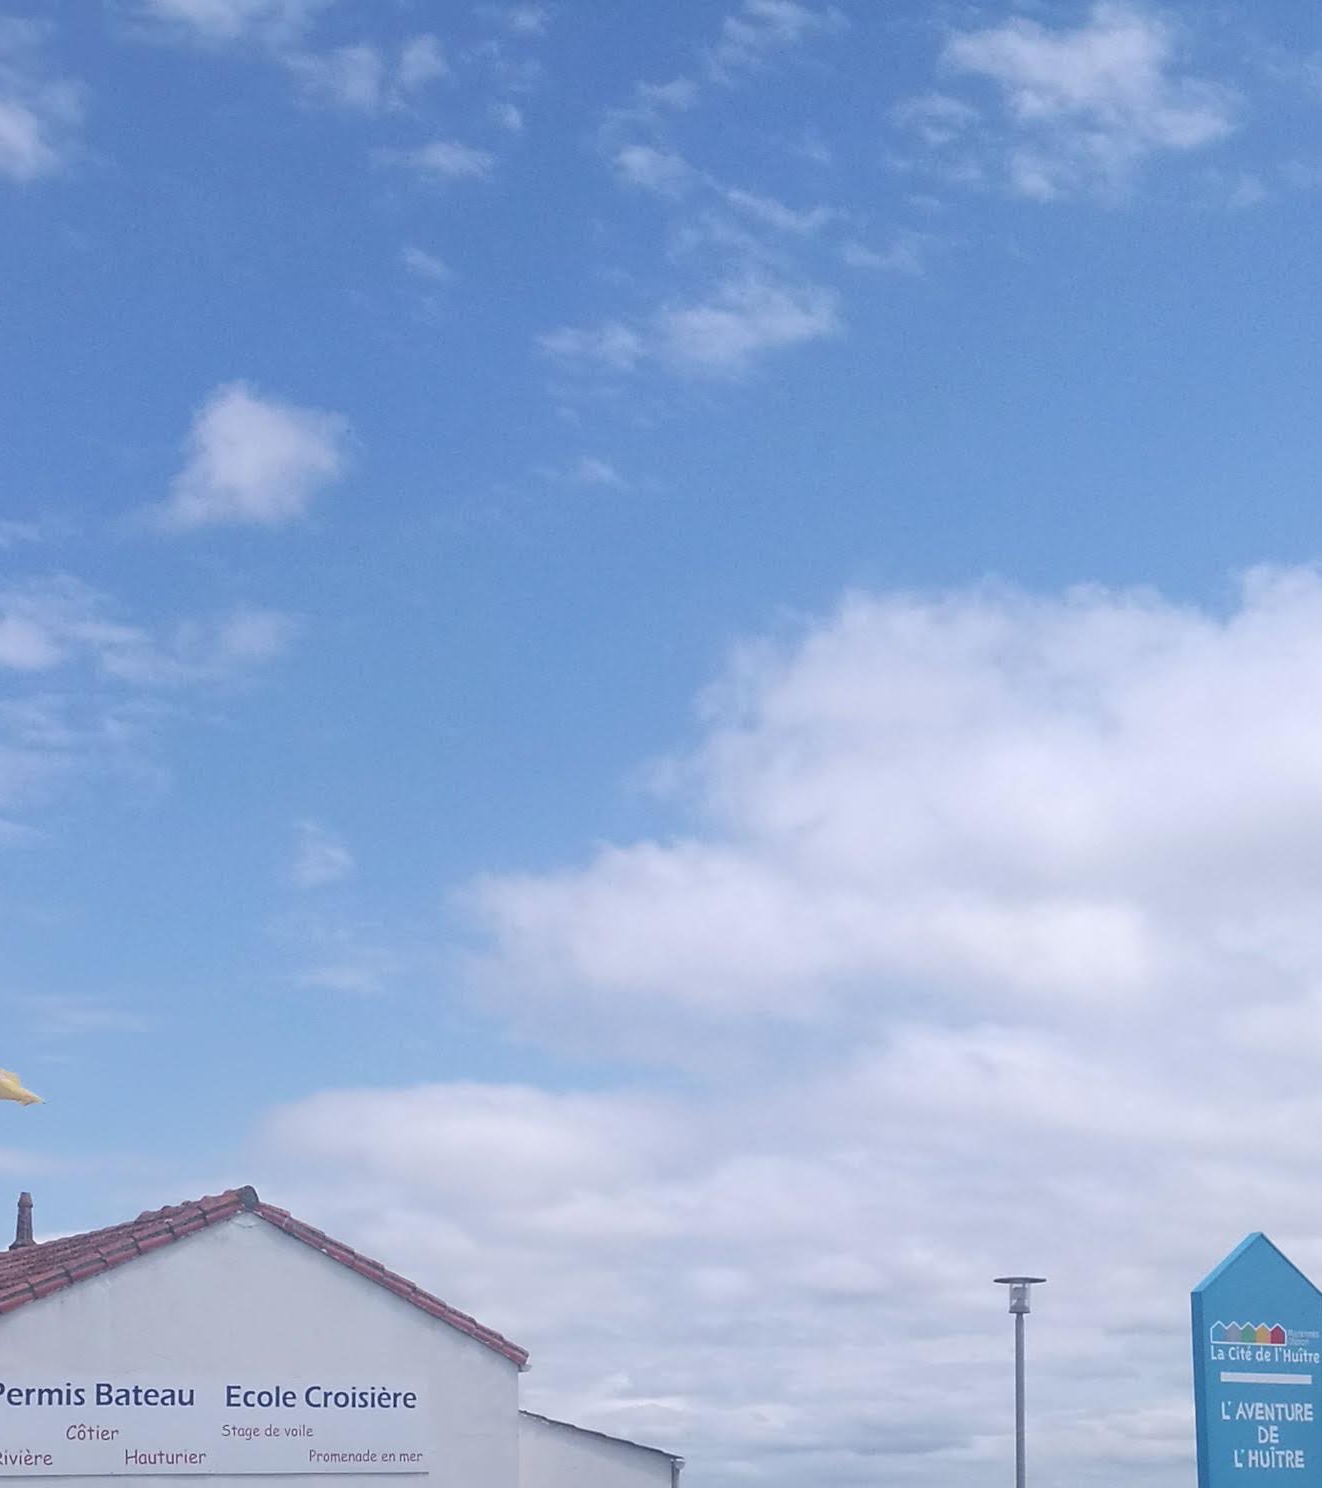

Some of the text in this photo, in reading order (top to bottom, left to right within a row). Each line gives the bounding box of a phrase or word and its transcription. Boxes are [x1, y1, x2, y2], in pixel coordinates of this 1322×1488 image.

[1210, 1345, 1320, 1363] La Cité de l'Huître
[95, 1383, 195, 1407] Bateau
[225, 1385, 418, 1409] Ecole Croisière
[1236, 1403, 1314, 1421] AVENTURE
[65, 1424, 119, 1442] Côtier
[221, 1423, 314, 1439] Stage de voile
[1258, 1427, 1280, 1444] DE
[124, 1449, 207, 1466] Hauturier
[308, 1449, 423, 1464] Promenade en mer
[1247, 1447, 1305, 1469] HUÎTRE
